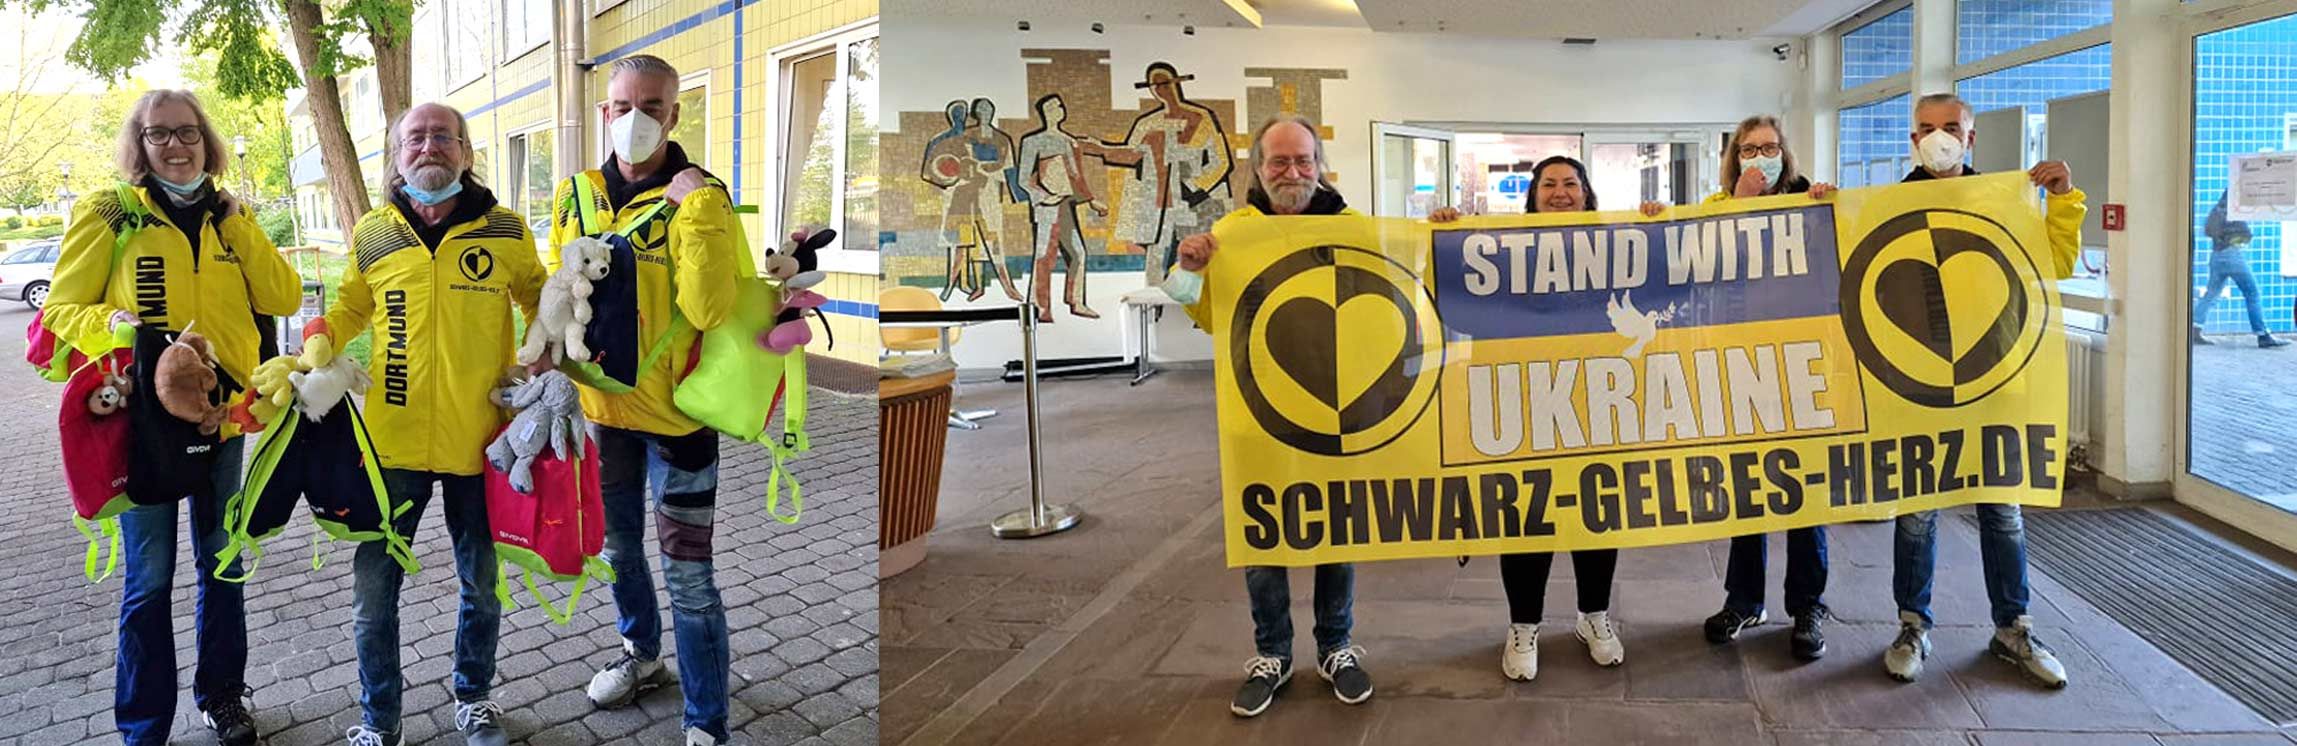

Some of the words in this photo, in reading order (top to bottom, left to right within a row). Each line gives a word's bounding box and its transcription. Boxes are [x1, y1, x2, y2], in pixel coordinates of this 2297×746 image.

[1462, 228, 1649, 297] STAND
[1664, 213, 1809, 286] WITH
[385, 290, 408, 408] DORTMUND
[1467, 340, 1836, 457] UKRAINE
[1241, 424, 2058, 551] SCHWARZ-GELBES-HERZ.DE
